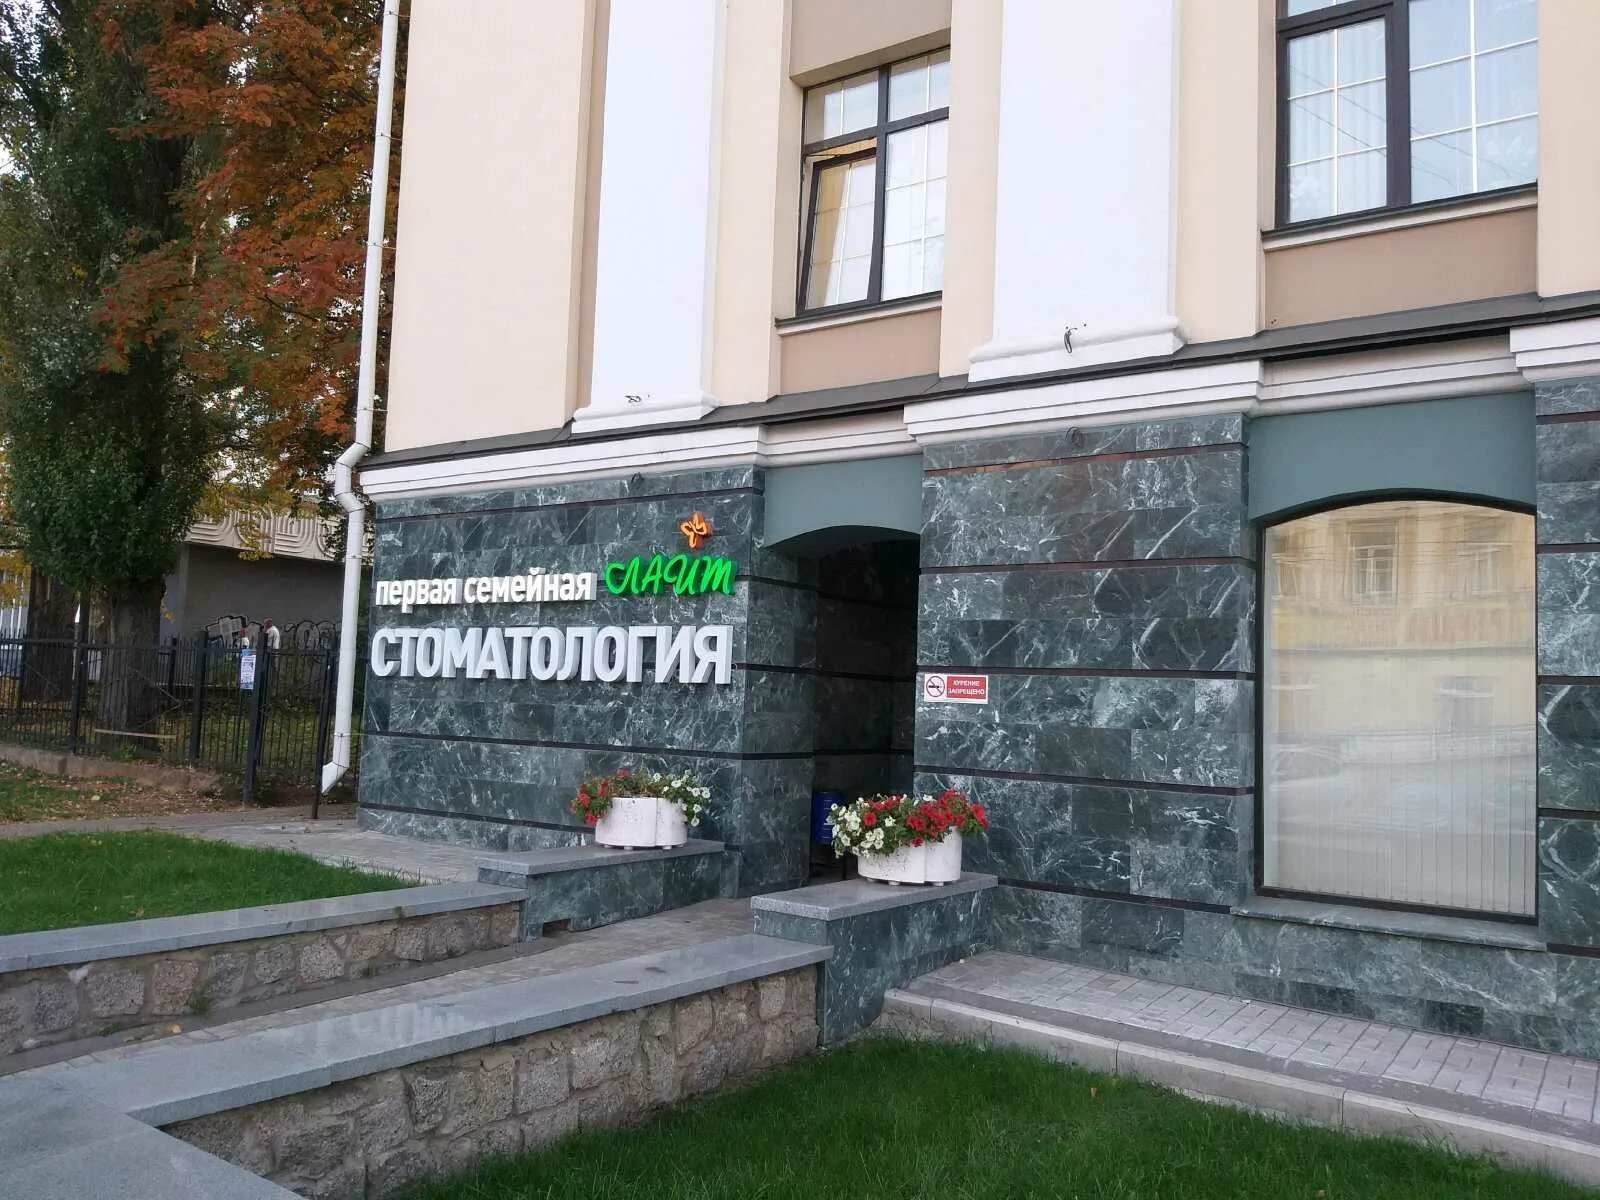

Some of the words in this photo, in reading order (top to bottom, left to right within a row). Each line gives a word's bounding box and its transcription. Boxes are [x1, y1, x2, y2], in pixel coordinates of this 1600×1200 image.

[375, 578, 462, 614] первая
[463, 567, 597, 604] семейная
[371, 625, 734, 685] СТОМАТОЛОГИЯ
[949, 688, 985, 696] ЗАПРЕЩЕНО
